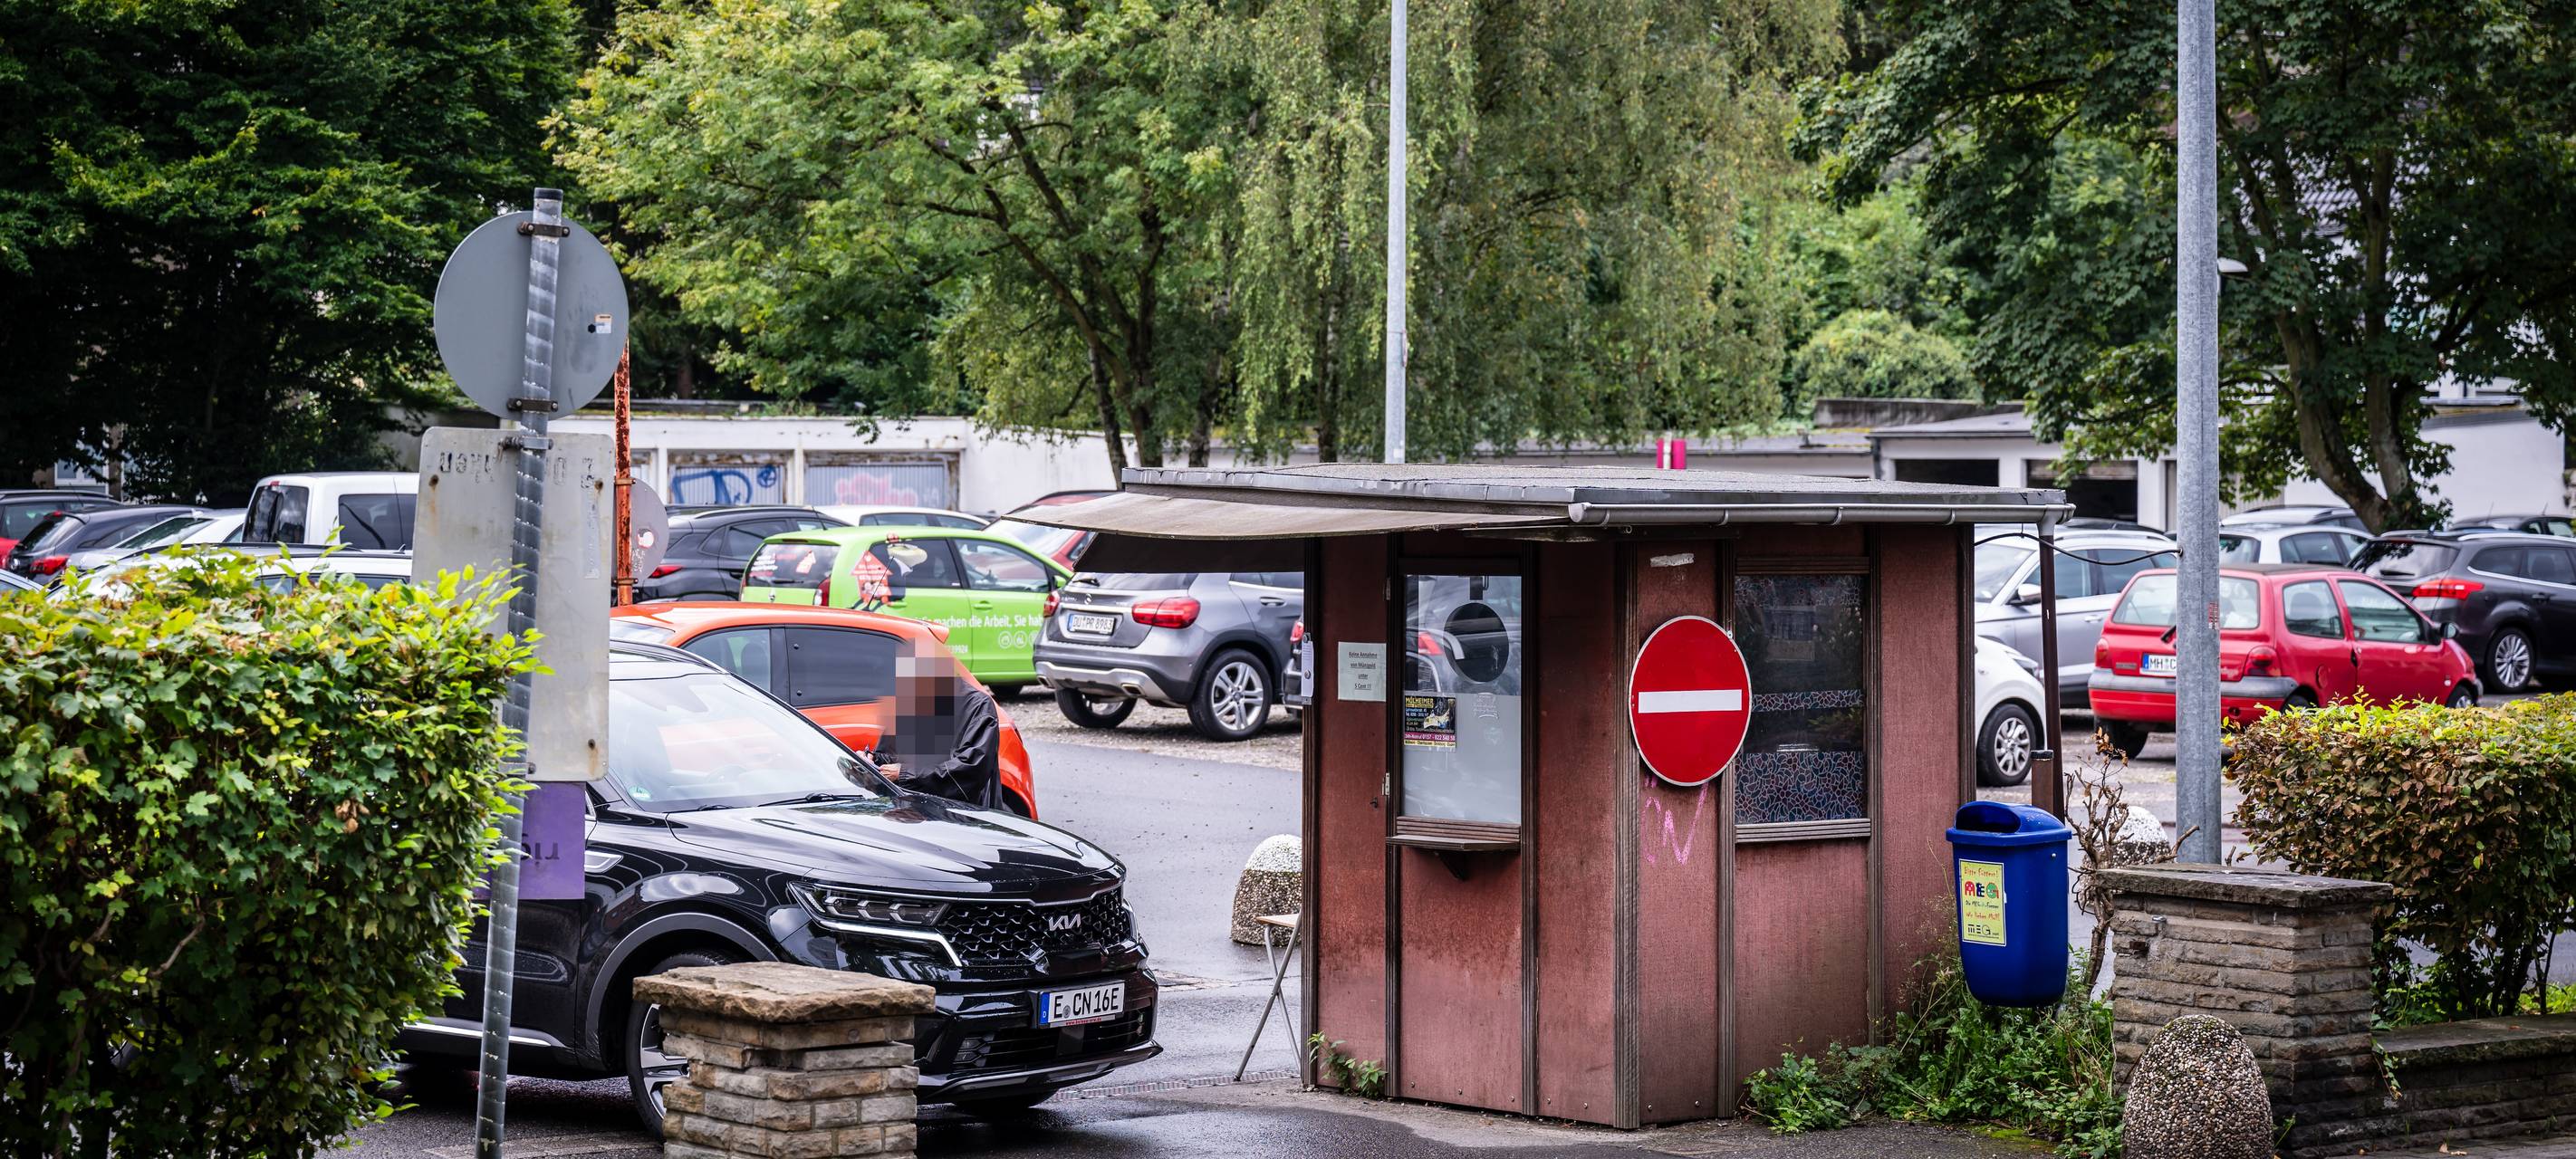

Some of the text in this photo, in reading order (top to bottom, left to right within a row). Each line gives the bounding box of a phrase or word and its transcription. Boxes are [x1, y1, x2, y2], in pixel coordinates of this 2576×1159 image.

[934, 616, 967, 627] machen
[969, 615, 983, 627] die
[1014, 615, 1027, 627] Sie
[2150, 658, 2163, 668] MH
[1405, 696, 1434, 704] MÜLHEIMER
[1054, 995, 1063, 1019] E
